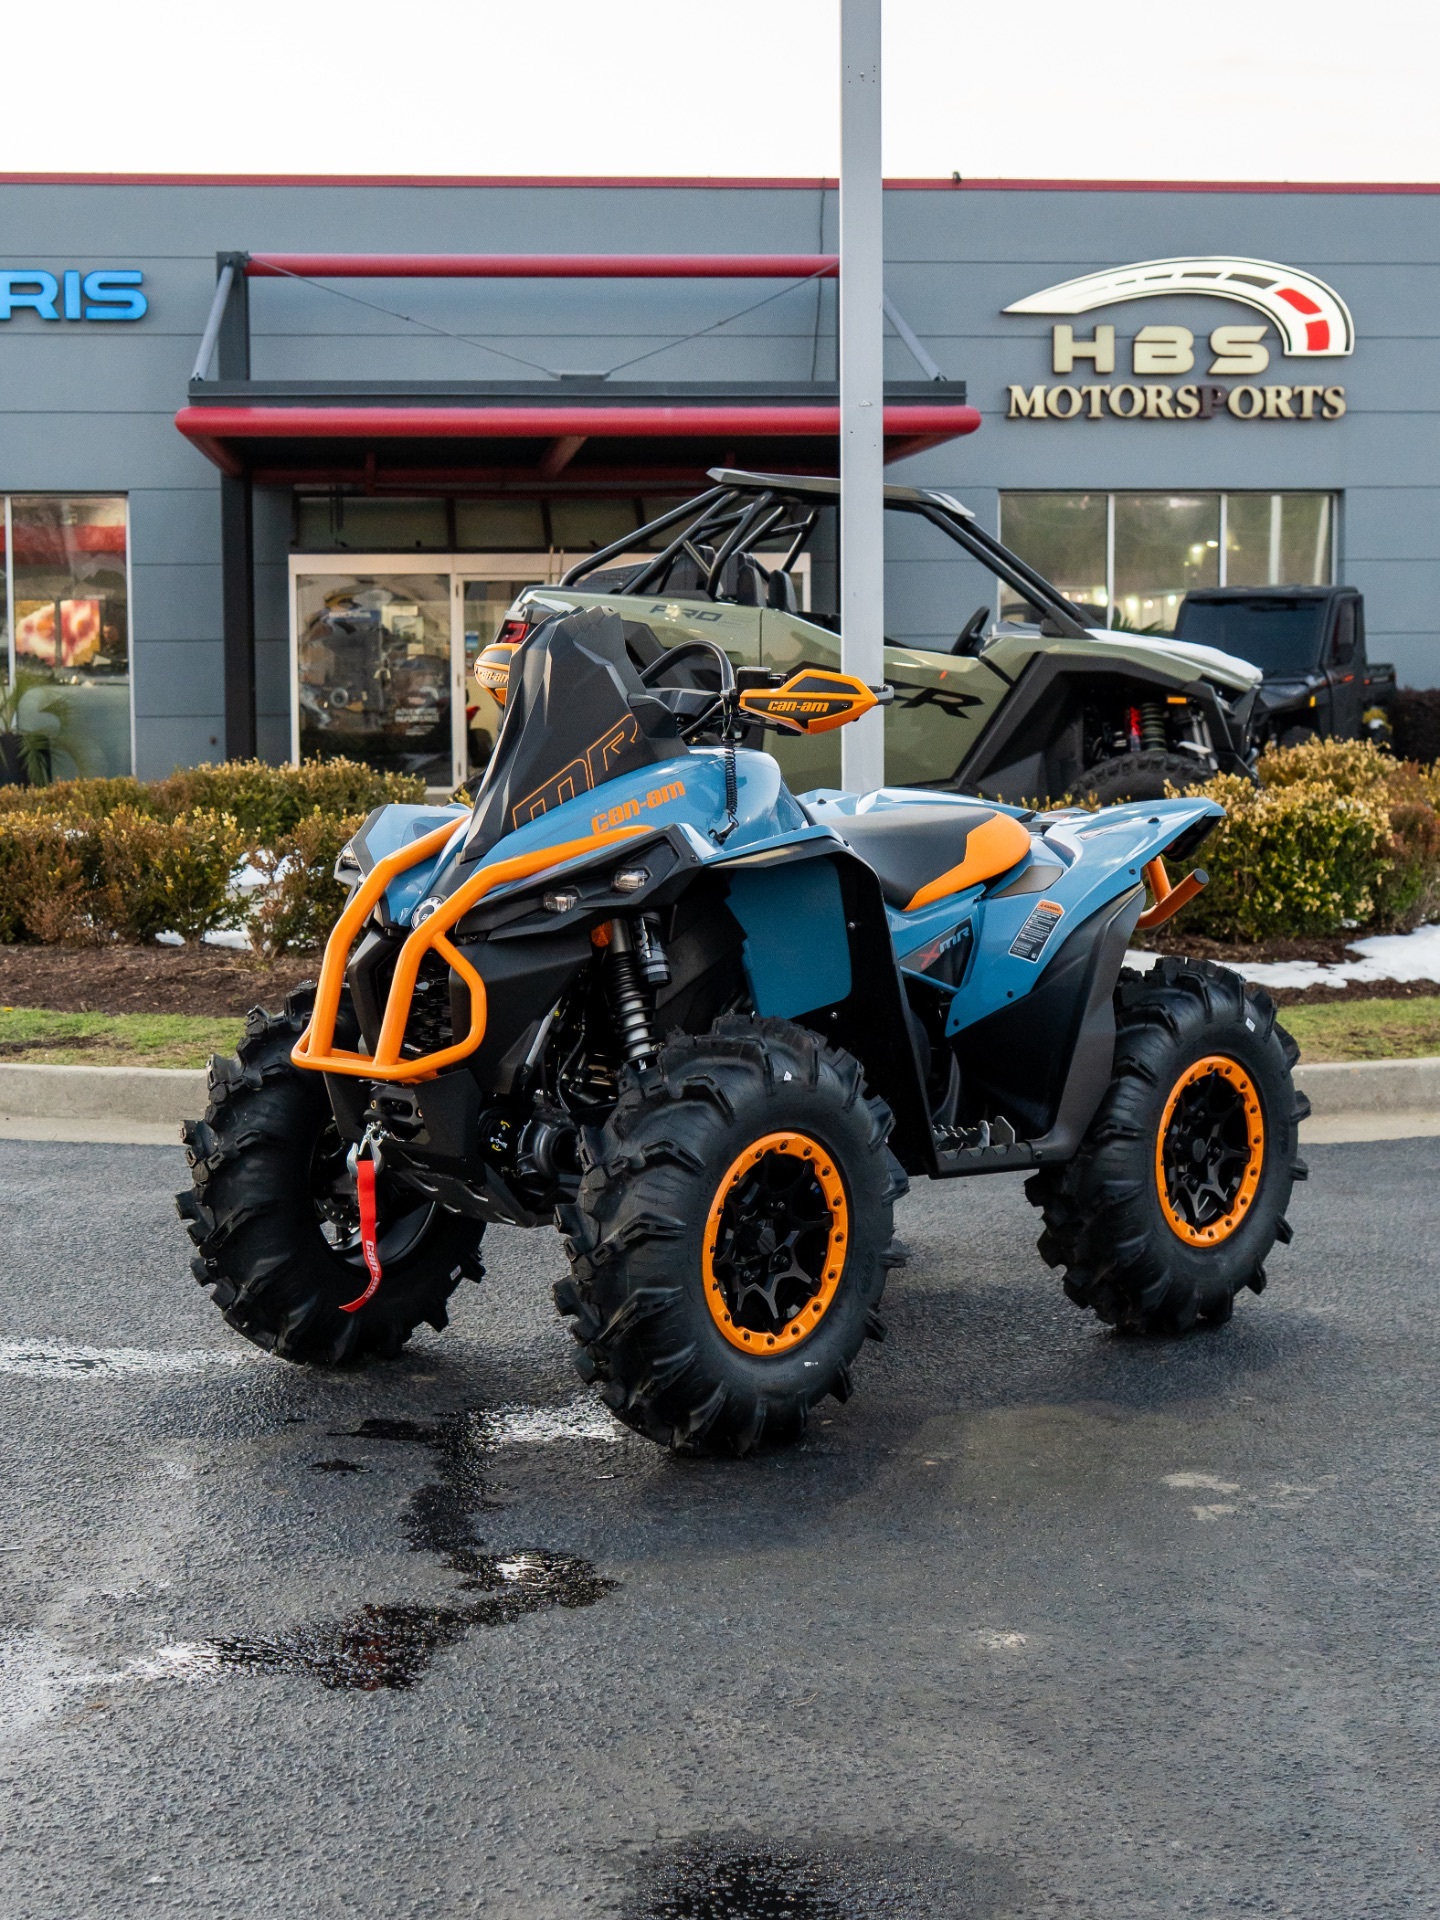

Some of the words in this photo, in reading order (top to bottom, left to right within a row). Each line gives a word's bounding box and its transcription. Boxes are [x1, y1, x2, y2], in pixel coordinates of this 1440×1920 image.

[0, 269, 148, 321] RIS
[1052, 324, 1270, 375] HBS
[1006, 384, 1347, 420] MOTORSPORTS
[767, 700, 830, 713] can-am
[591, 780, 686, 836] can-am
